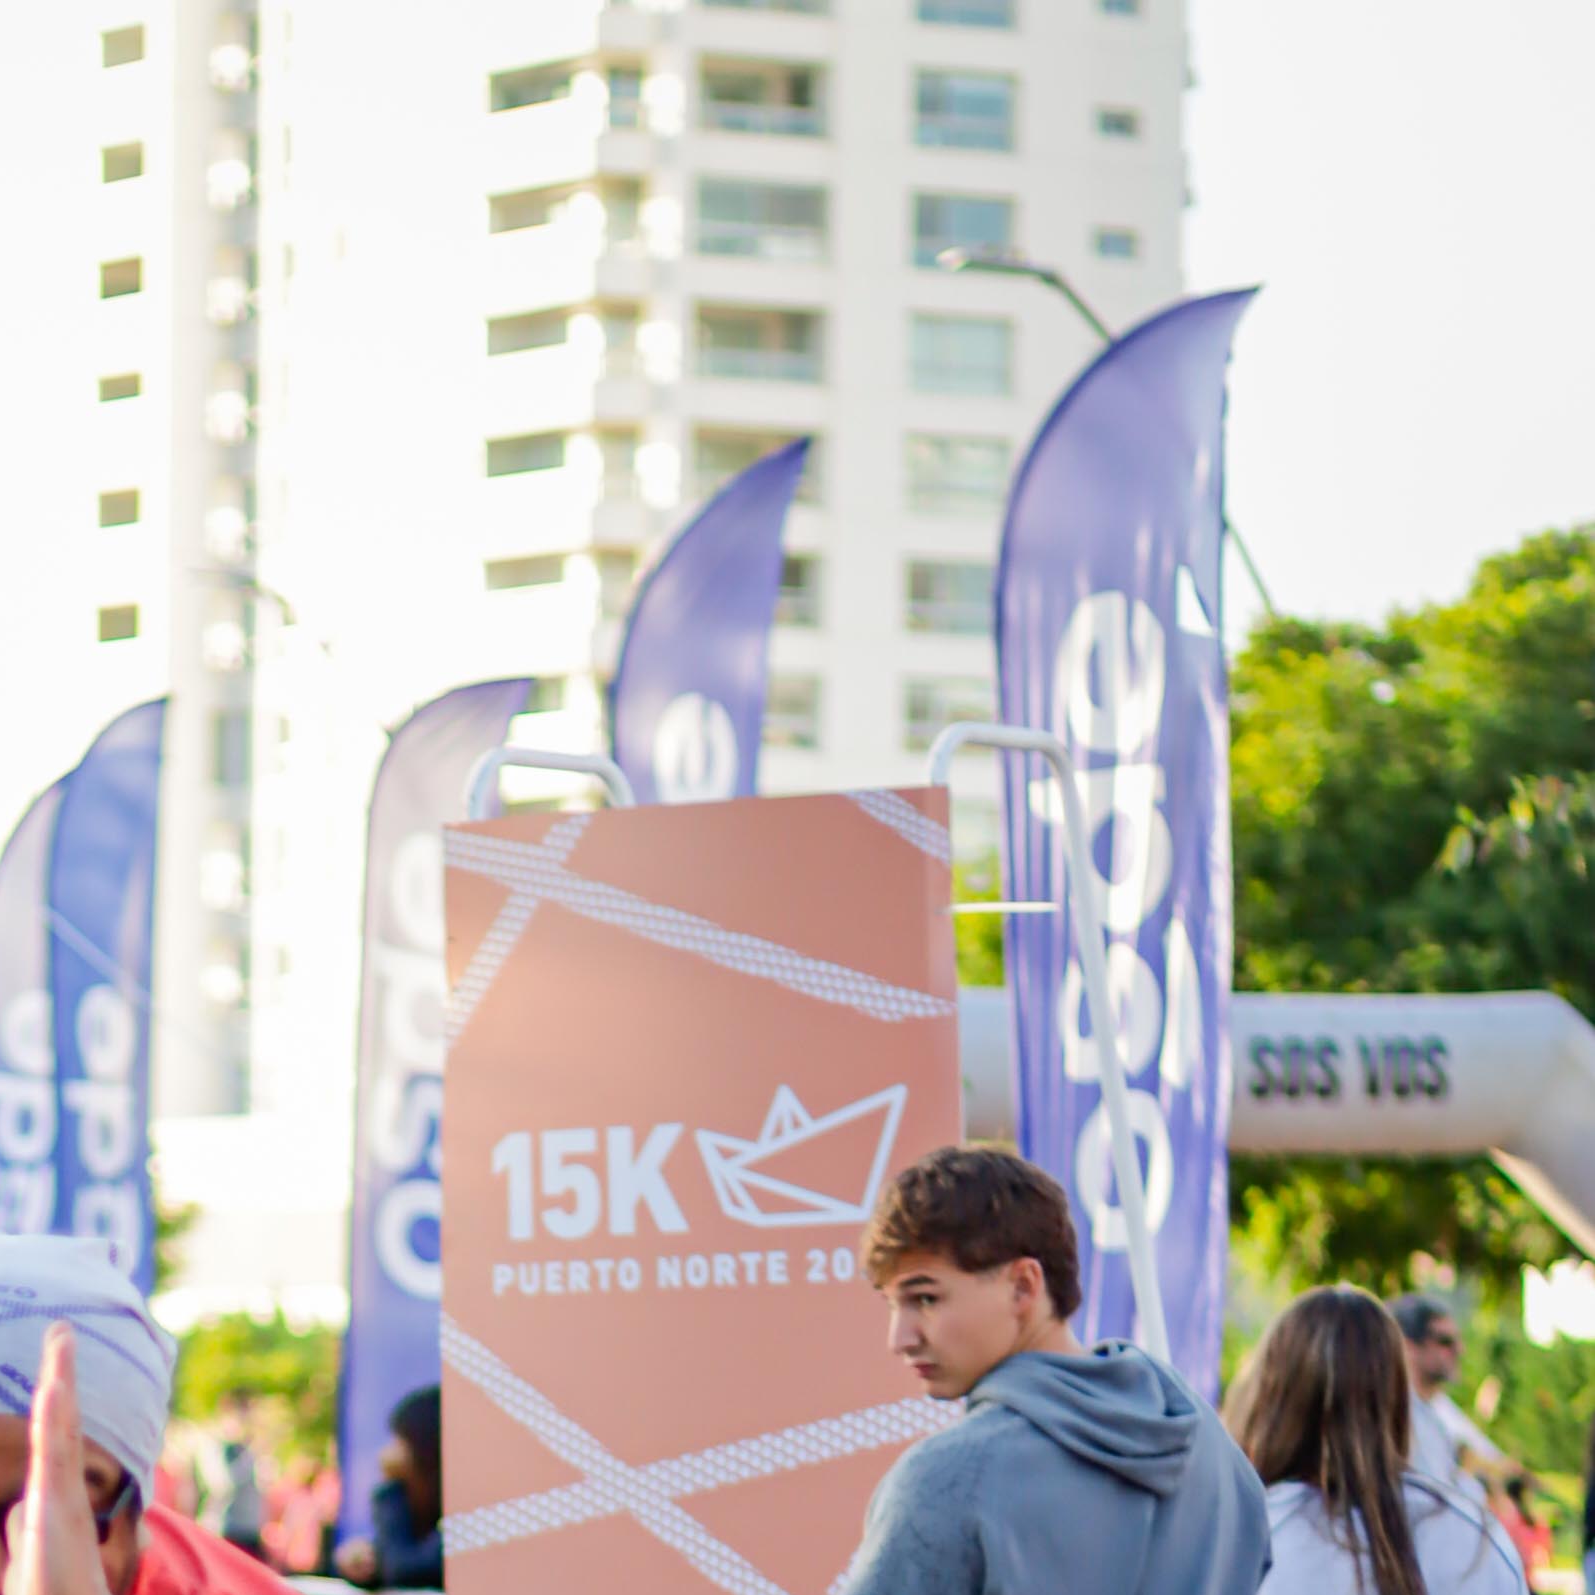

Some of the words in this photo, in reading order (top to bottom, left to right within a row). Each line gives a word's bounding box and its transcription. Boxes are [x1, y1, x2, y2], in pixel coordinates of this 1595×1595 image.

[491, 1121, 691, 1241] 15K
[492, 1256, 642, 1297] PUERTO
[656, 1250, 790, 1290] NORTE
[807, 1247, 867, 1282] 20
